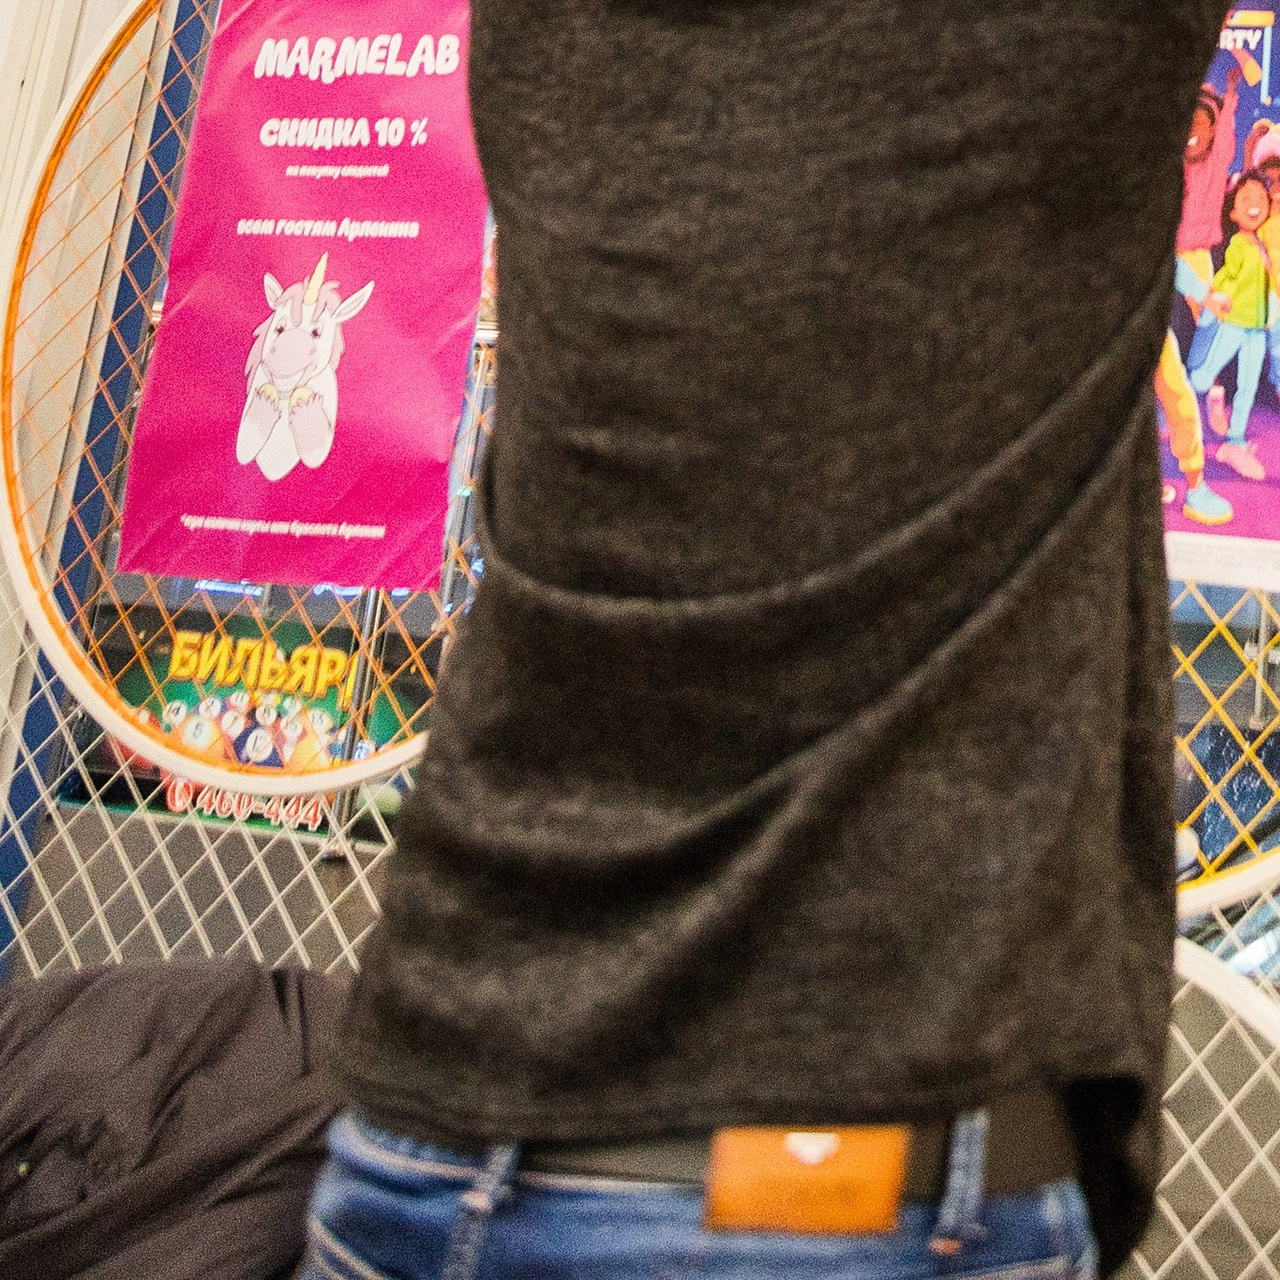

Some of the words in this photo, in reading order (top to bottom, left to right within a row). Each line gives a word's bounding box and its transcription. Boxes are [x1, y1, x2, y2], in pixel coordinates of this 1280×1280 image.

[1217, 28, 1262, 51] RTY
[254, 33, 460, 84] MARMELAB
[259, 116, 371, 150] СКИДКА
[375, 117, 405, 147] 10
[410, 116, 428, 147] %
[237, 219, 275, 235] всем
[276, 219, 337, 237] гостям
[197, 785, 323, 831] 460-444
